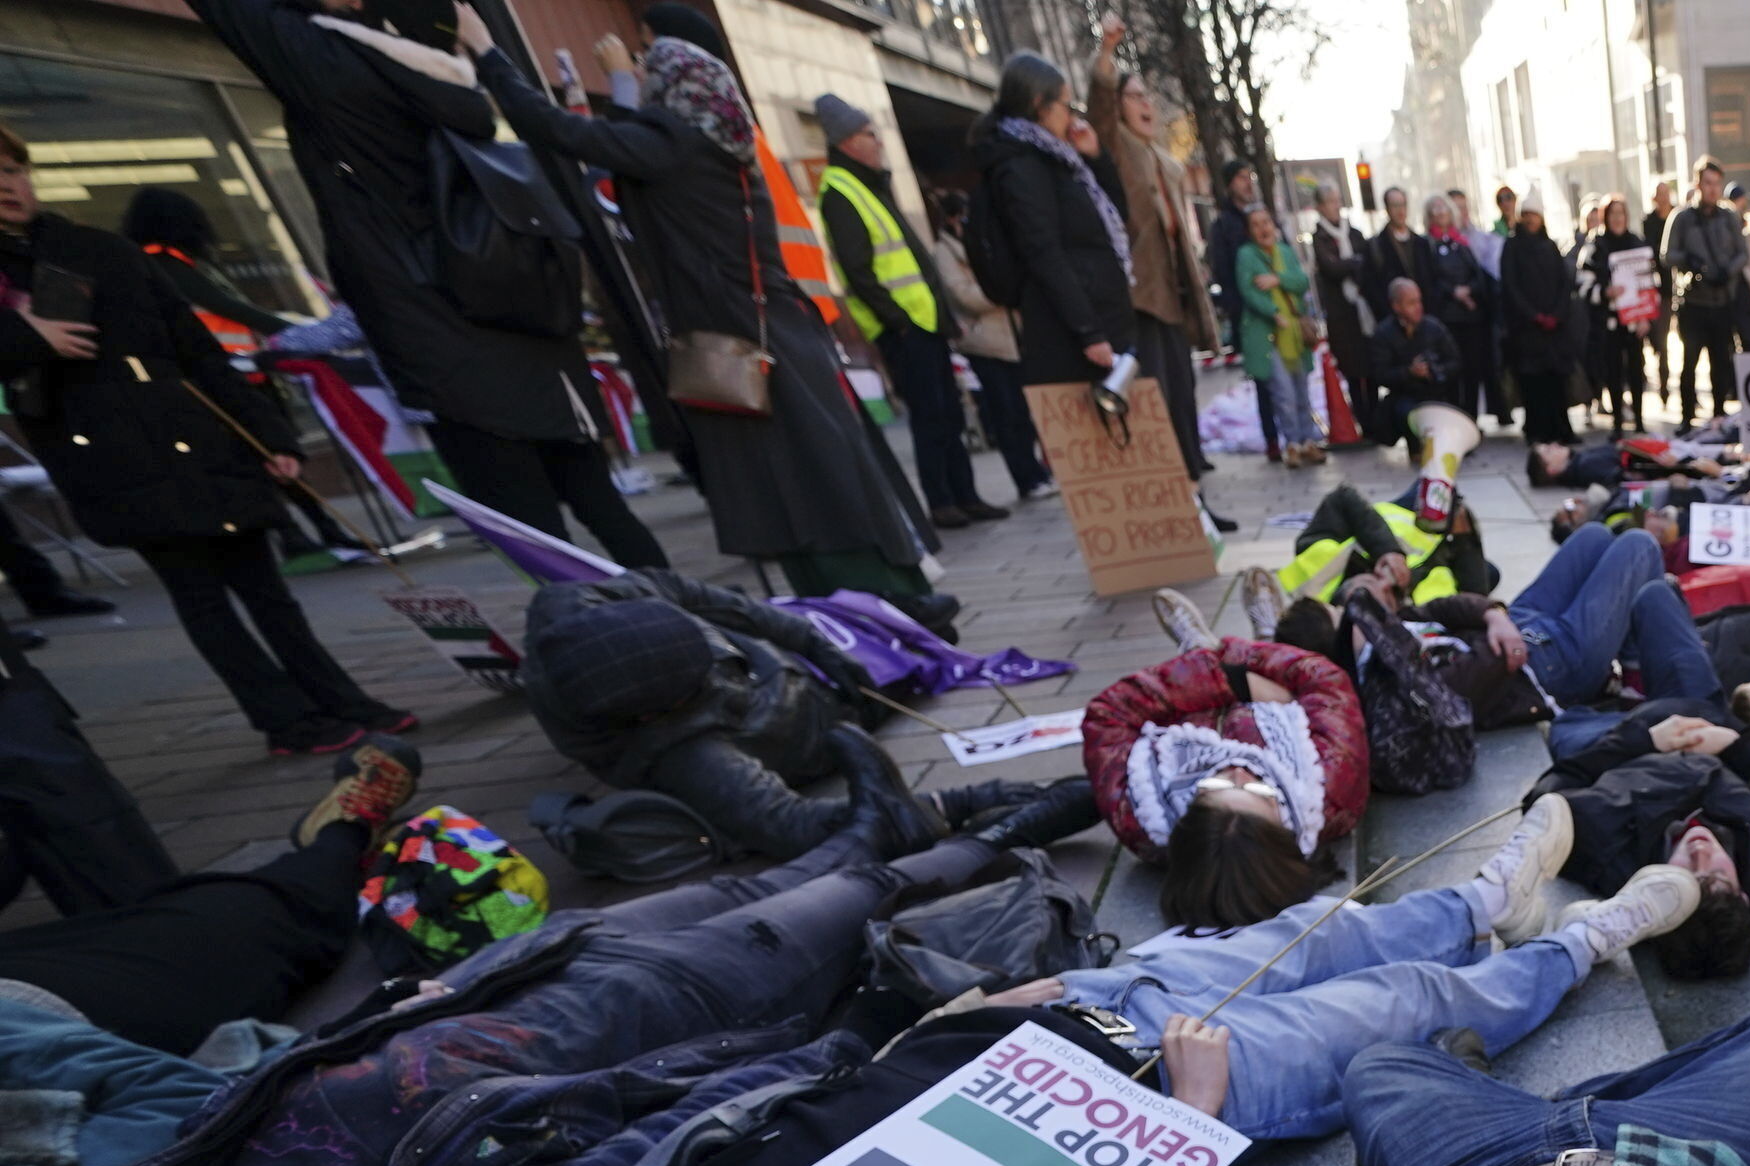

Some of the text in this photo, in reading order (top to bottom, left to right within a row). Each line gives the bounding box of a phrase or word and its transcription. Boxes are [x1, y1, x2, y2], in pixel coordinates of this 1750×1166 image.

[1121, 475, 1192, 513] RIGHT
[1077, 525, 1117, 559] TO
[959, 1069, 1059, 1131] THE
[1026, 1032, 1231, 1147] www.scottishpsc.org.uk
